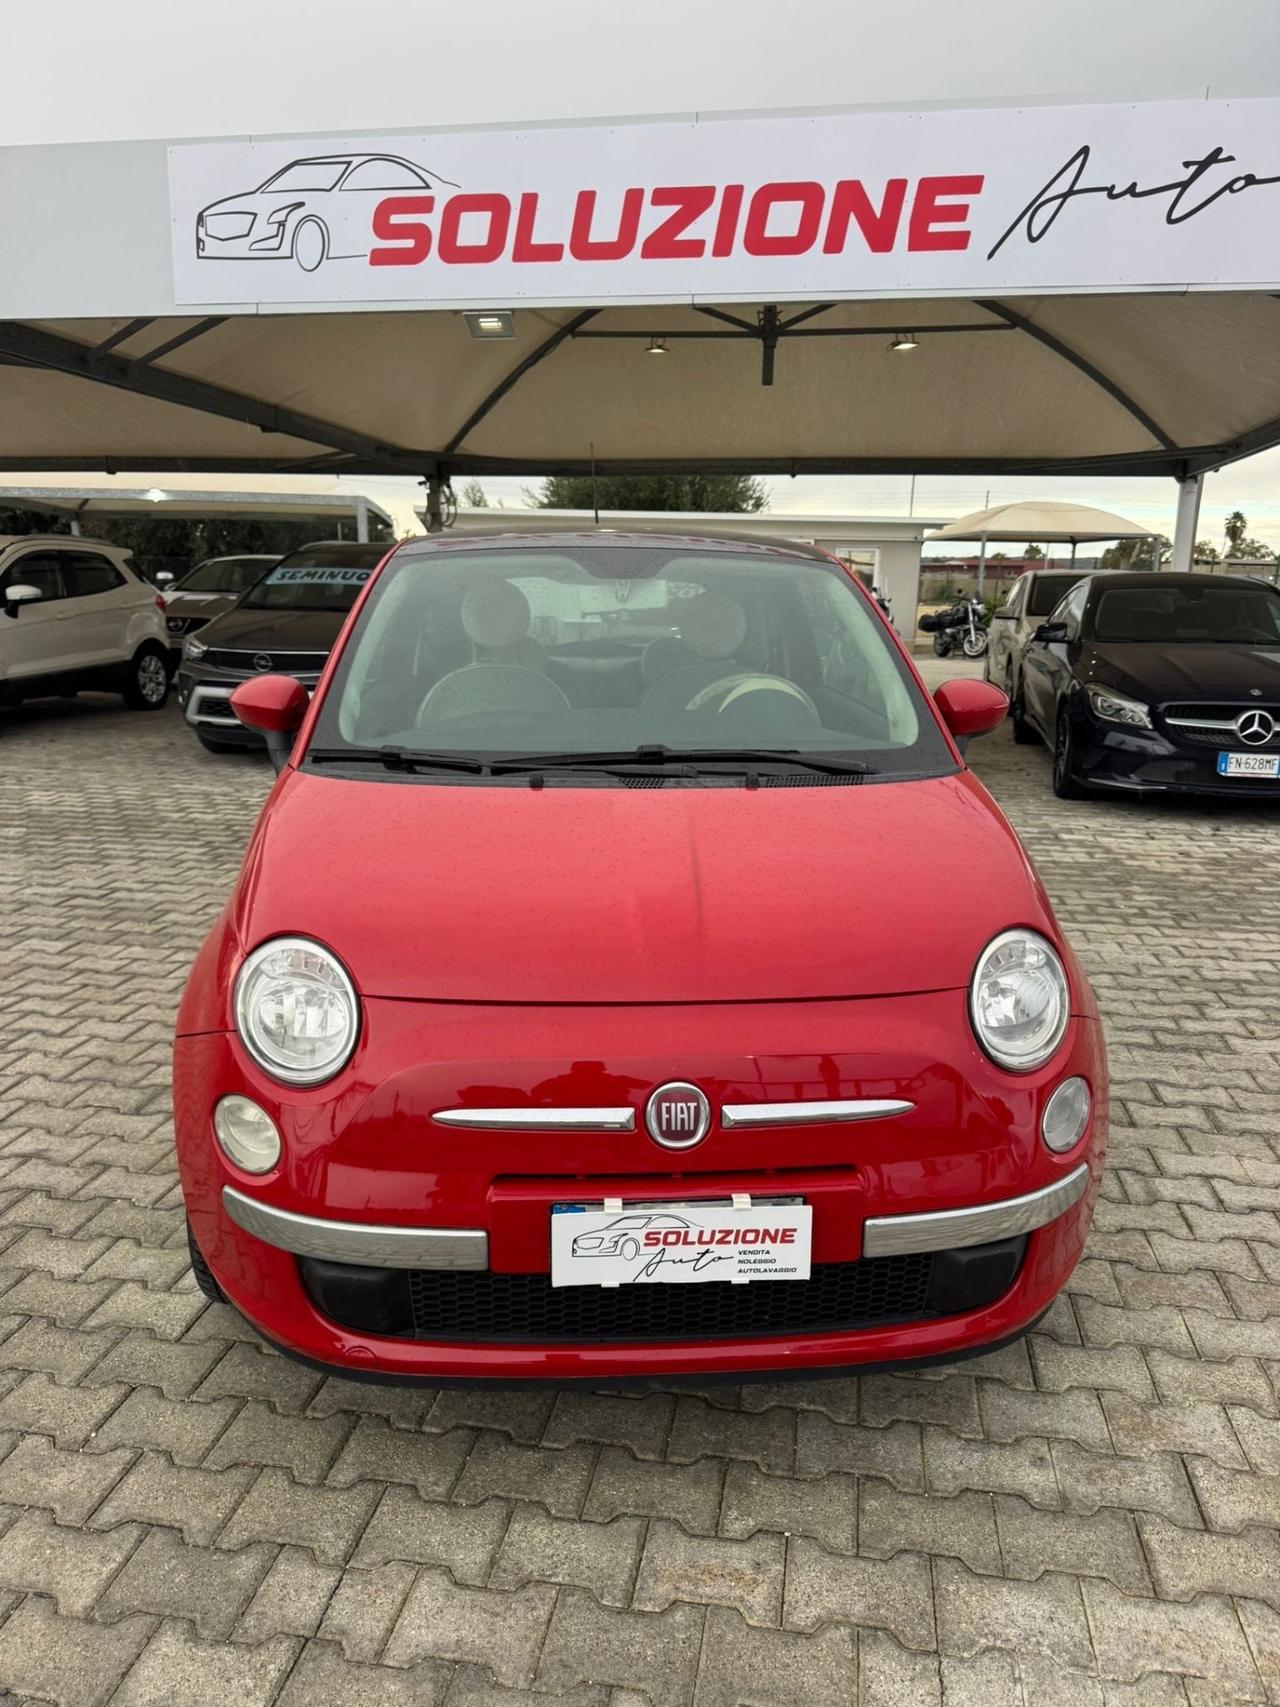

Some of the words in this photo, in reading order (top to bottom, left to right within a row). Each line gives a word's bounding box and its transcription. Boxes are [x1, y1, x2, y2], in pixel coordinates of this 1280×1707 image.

[369, 174, 986, 267] SOLUZIONE
[987, 144, 1280, 261] Auto
[661, 1102, 698, 1131] FIAT
[643, 1228, 798, 1247] SOLUZIONE
[633, 1248, 734, 1282] Auto
